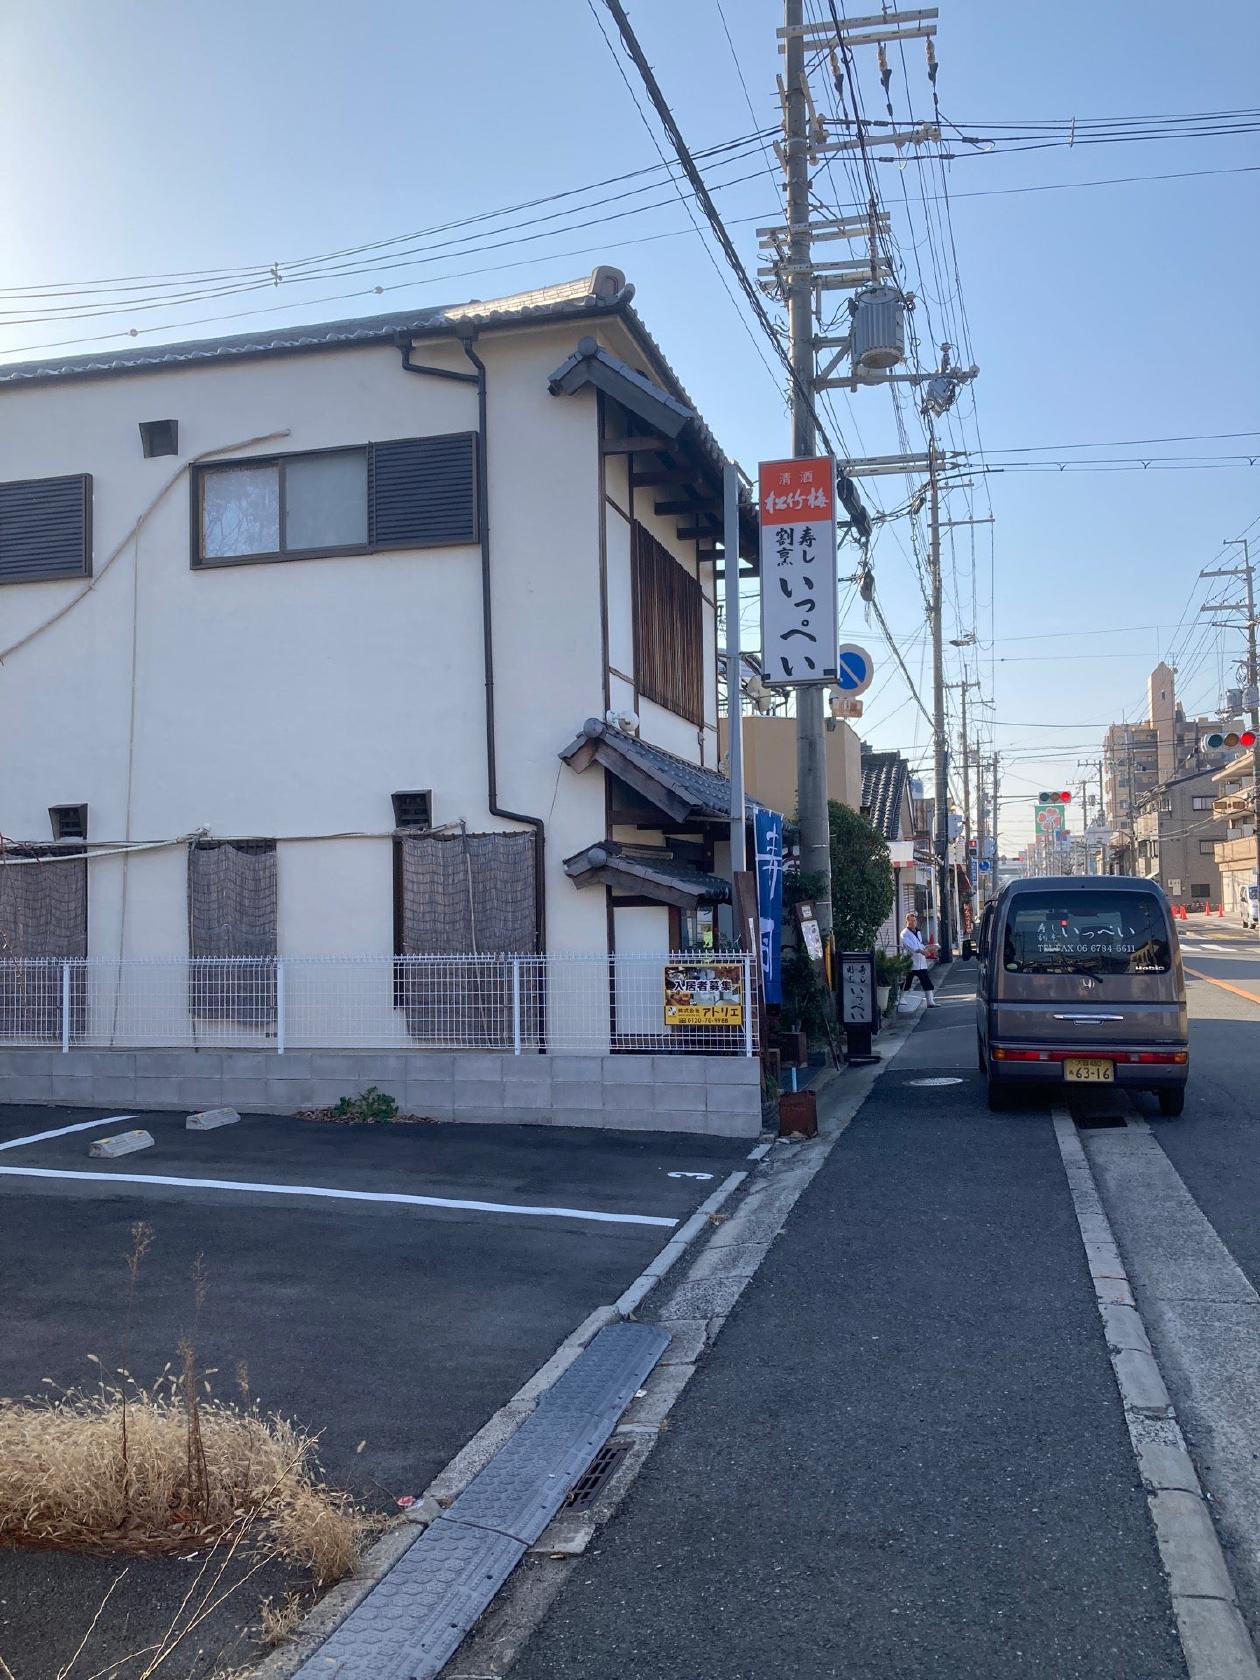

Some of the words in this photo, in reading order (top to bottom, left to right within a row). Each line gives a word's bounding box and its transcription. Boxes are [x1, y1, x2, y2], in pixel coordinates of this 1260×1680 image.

[779, 471, 813, 485] 清酒
[764, 487, 829, 514] 松竹梅
[798, 526, 816, 564] 寿し
[778, 576, 817, 677] いっぺい
[674, 980, 733, 992] 入居者募集
[702, 1006, 739, 1018] アトリエ
[1076, 1067, 1110, 1080] 63-16
